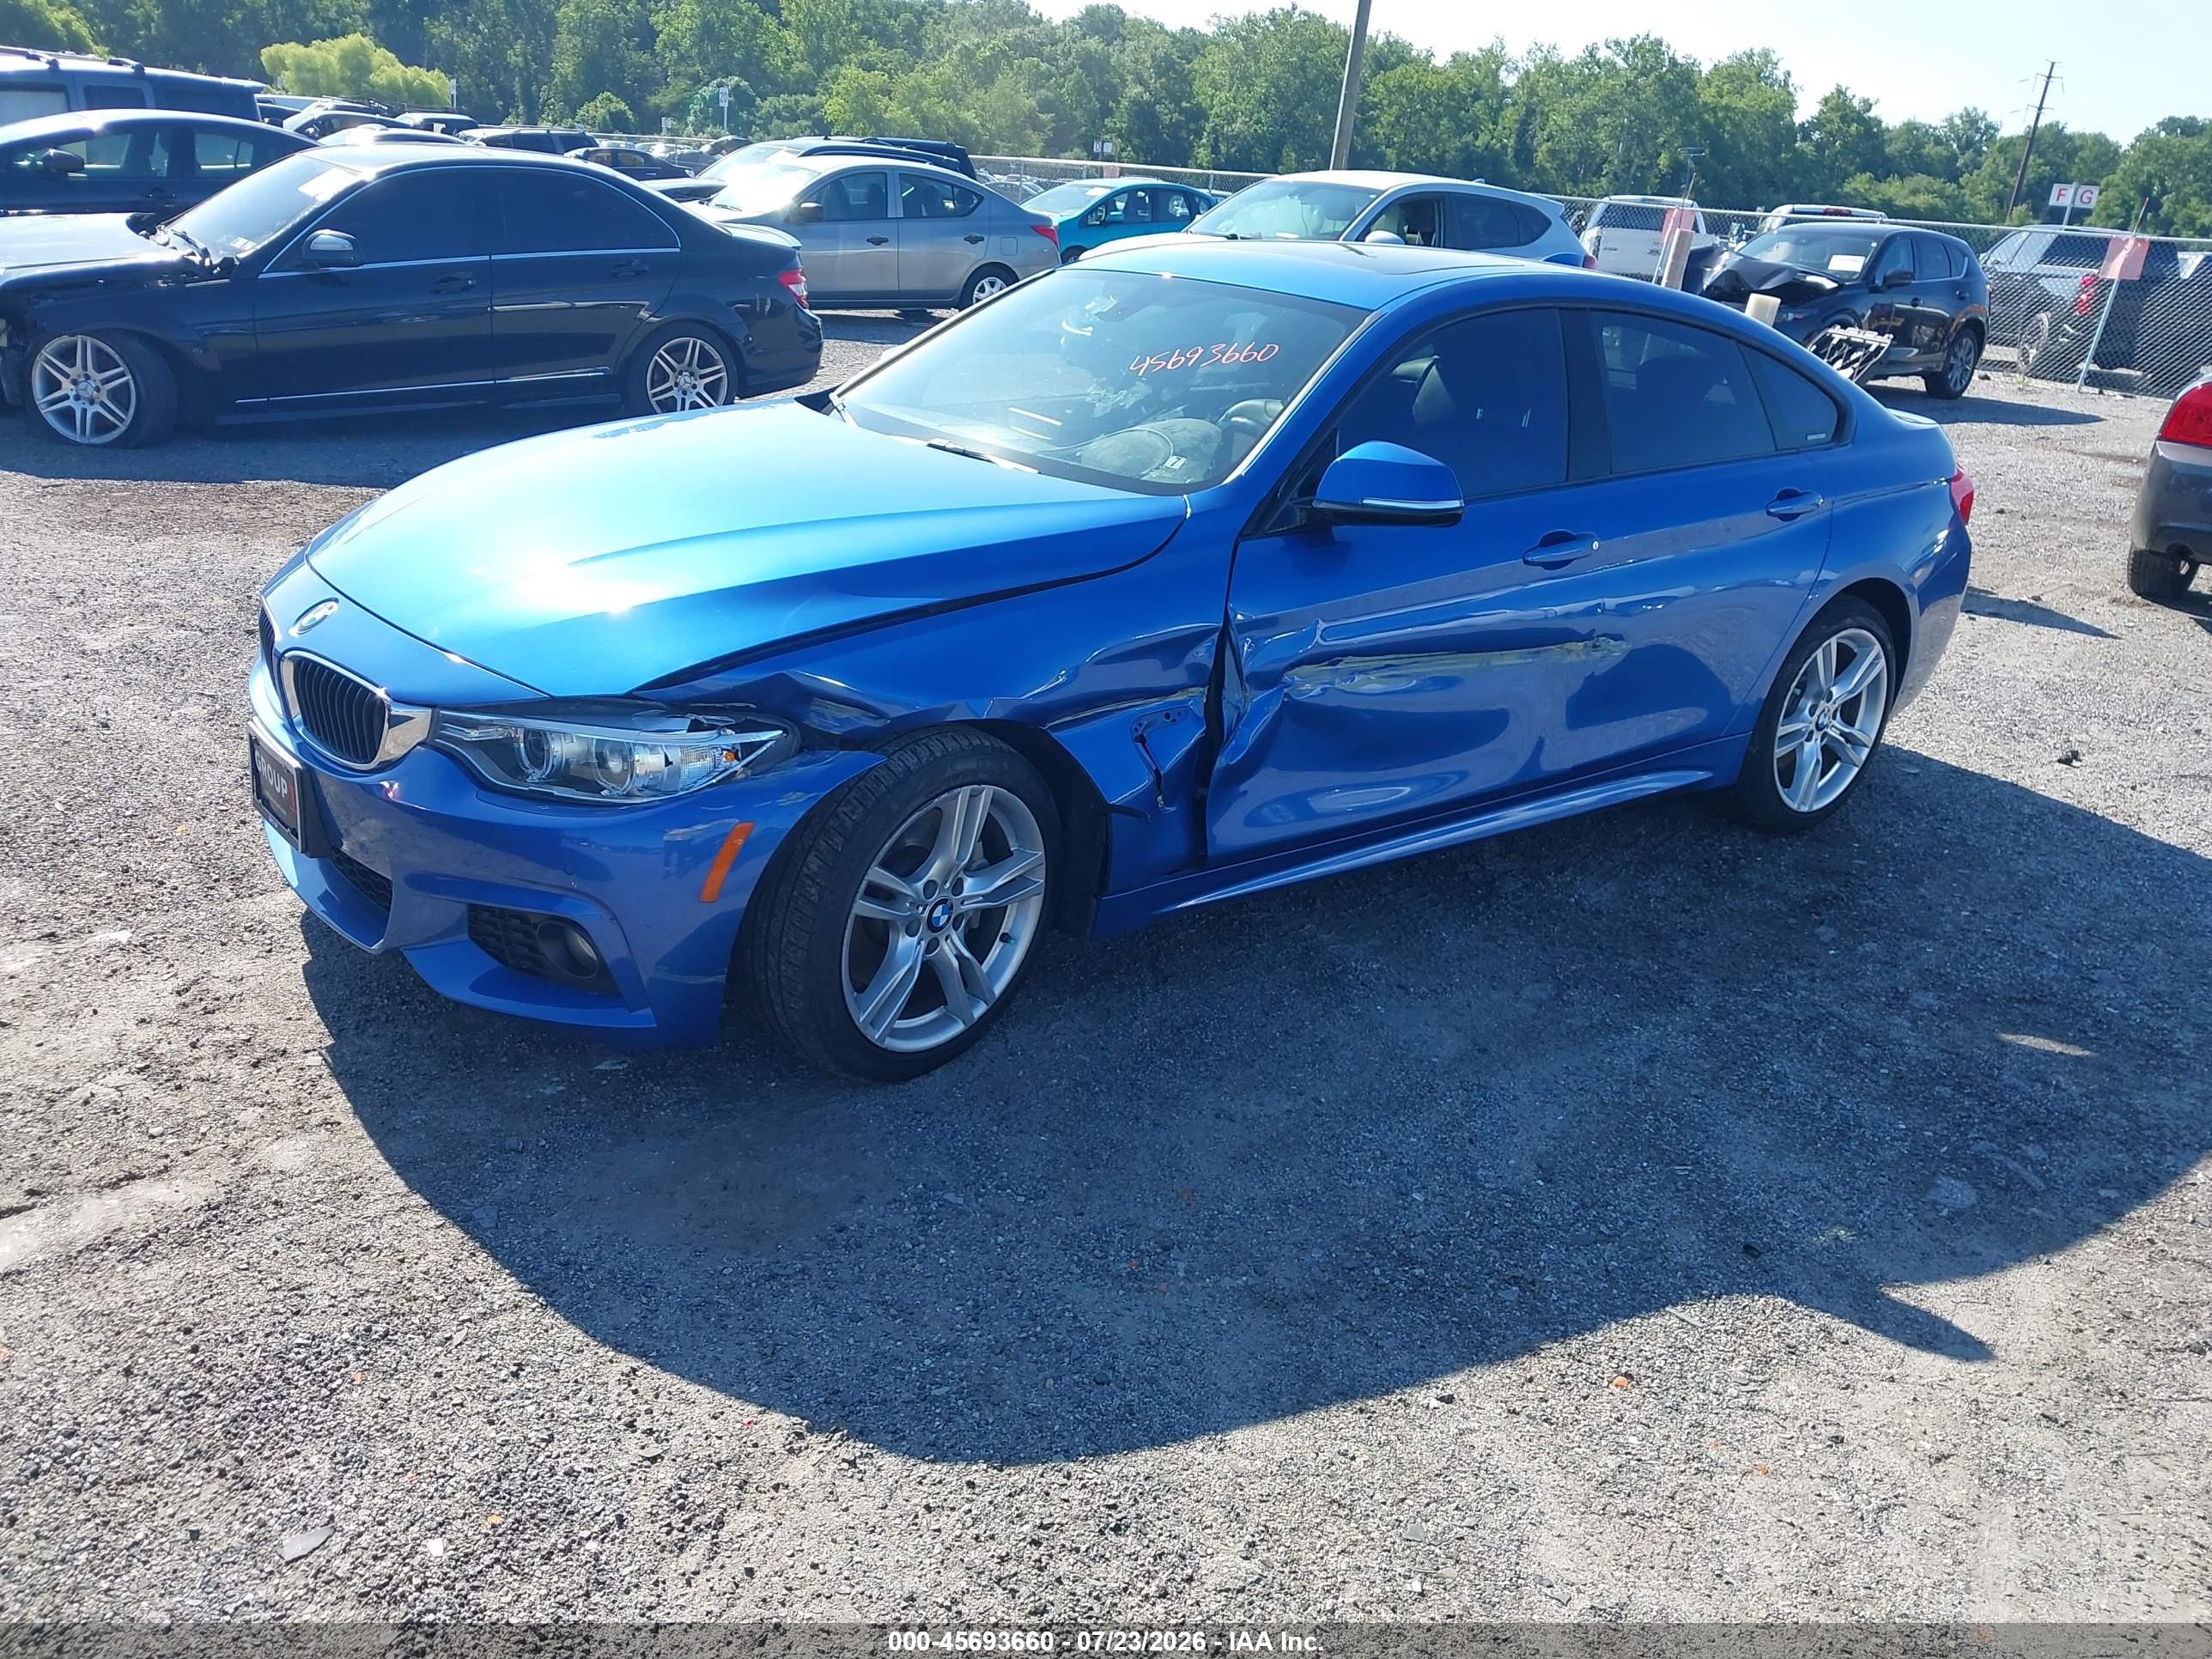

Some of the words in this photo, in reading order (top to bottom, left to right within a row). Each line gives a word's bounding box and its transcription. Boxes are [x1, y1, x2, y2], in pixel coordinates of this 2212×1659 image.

[2057, 188, 2068, 202] F
[2080, 190, 2094, 204] G
[1129, 341, 1279, 376] 45693660
[1170, 457, 1182, 466] 7
[254, 750, 288, 798] GROUP
